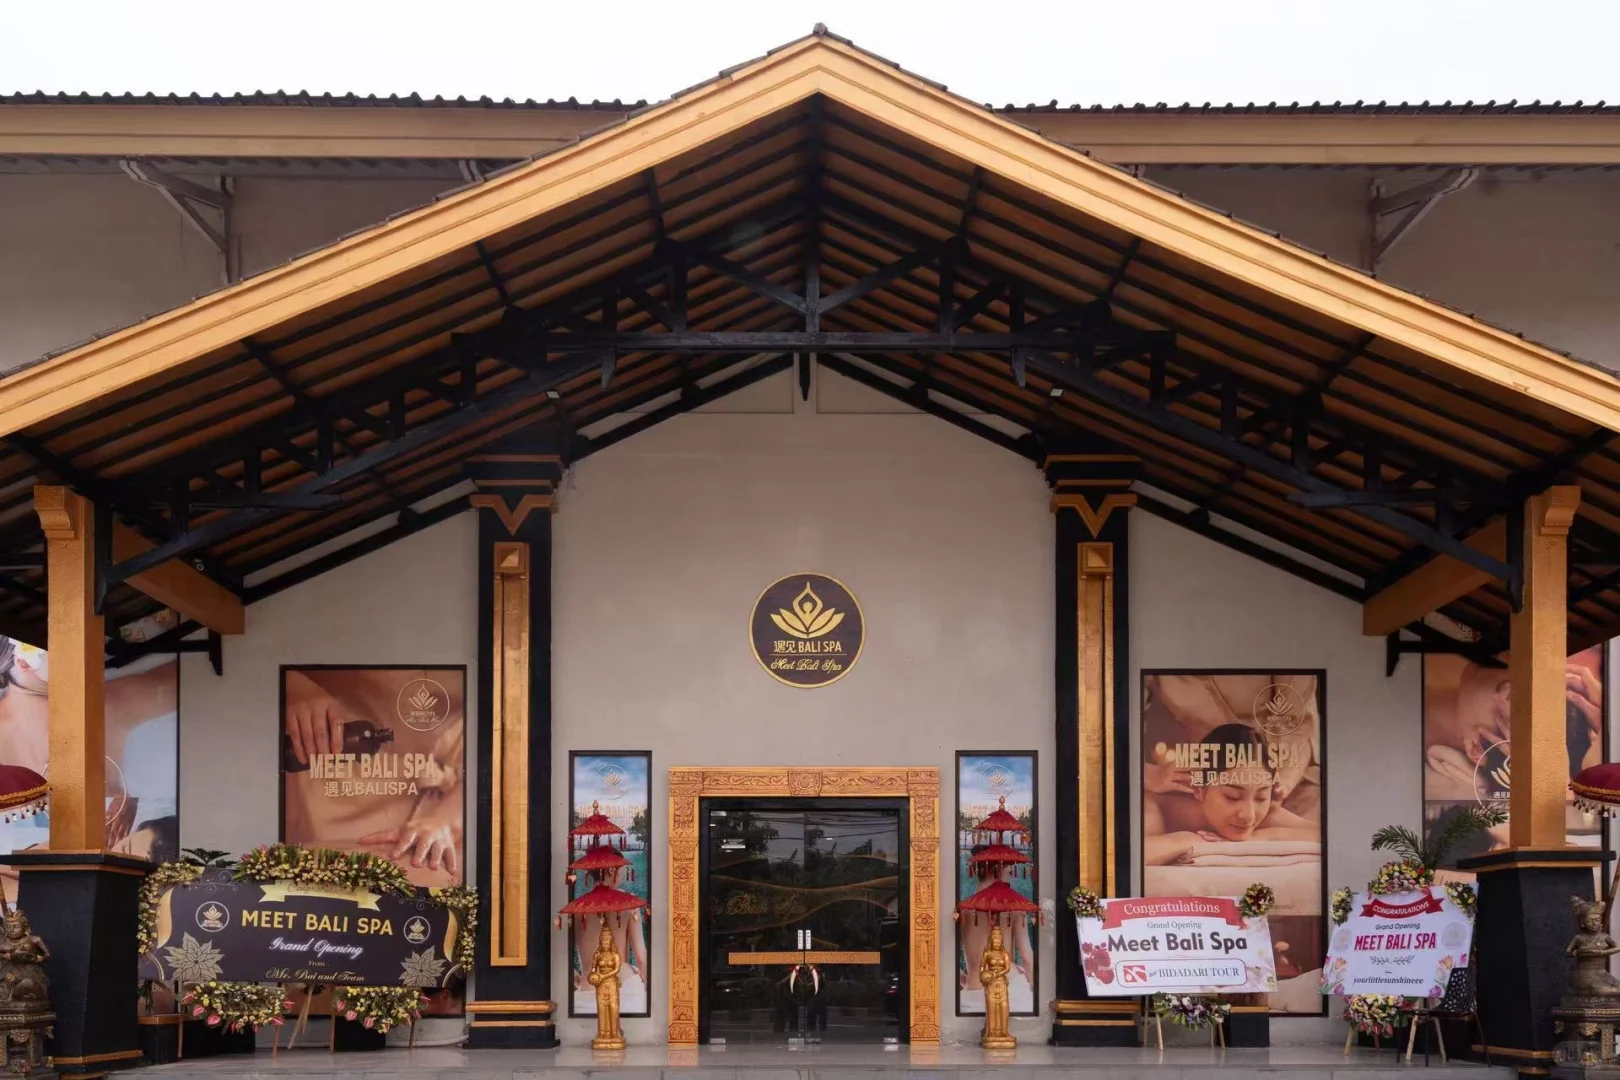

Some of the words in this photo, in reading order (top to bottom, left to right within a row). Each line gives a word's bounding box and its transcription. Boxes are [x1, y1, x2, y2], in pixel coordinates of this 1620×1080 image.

[798, 641, 820, 653] BALI
[823, 641, 842, 652] SPA
[770, 658, 796, 671] Meet
[796, 658, 819, 671] Bali
[821, 658, 842, 674] Spa
[1175, 743, 1221, 769] MEET
[1225, 743, 1263, 769] BALI
[1268, 742, 1300, 769] SPA
[310, 753, 356, 779] MEET
[361, 753, 398, 779] BALI
[403, 752, 436, 779] SPA
[1123, 899, 1221, 915] Congratulations
[1372, 901, 1430, 915] CONGRATULATIONS
[241, 909, 297, 929] MEET
[305, 913, 348, 933] BALI
[357, 917, 393, 936] SPA
[1147, 921, 1170, 929] Grand
[1171, 920, 1202, 930] Opening
[1394, 922, 1421, 930] Opening
[269, 936, 314, 952] Grand
[314, 938, 364, 959] Opening
[1108, 933, 1159, 952] Meet
[1165, 931, 1204, 951] Bali
[1209, 931, 1248, 955] Spa
[1354, 934, 1385, 951] MEET
[1385, 933, 1412, 950] BALI
[1414, 932, 1437, 949] SPA
[317, 969, 336, 981] and
[337, 970, 365, 982] Team
[1158, 968, 1208, 978] BIDADARI
[1210, 967, 1240, 977] TOUR
